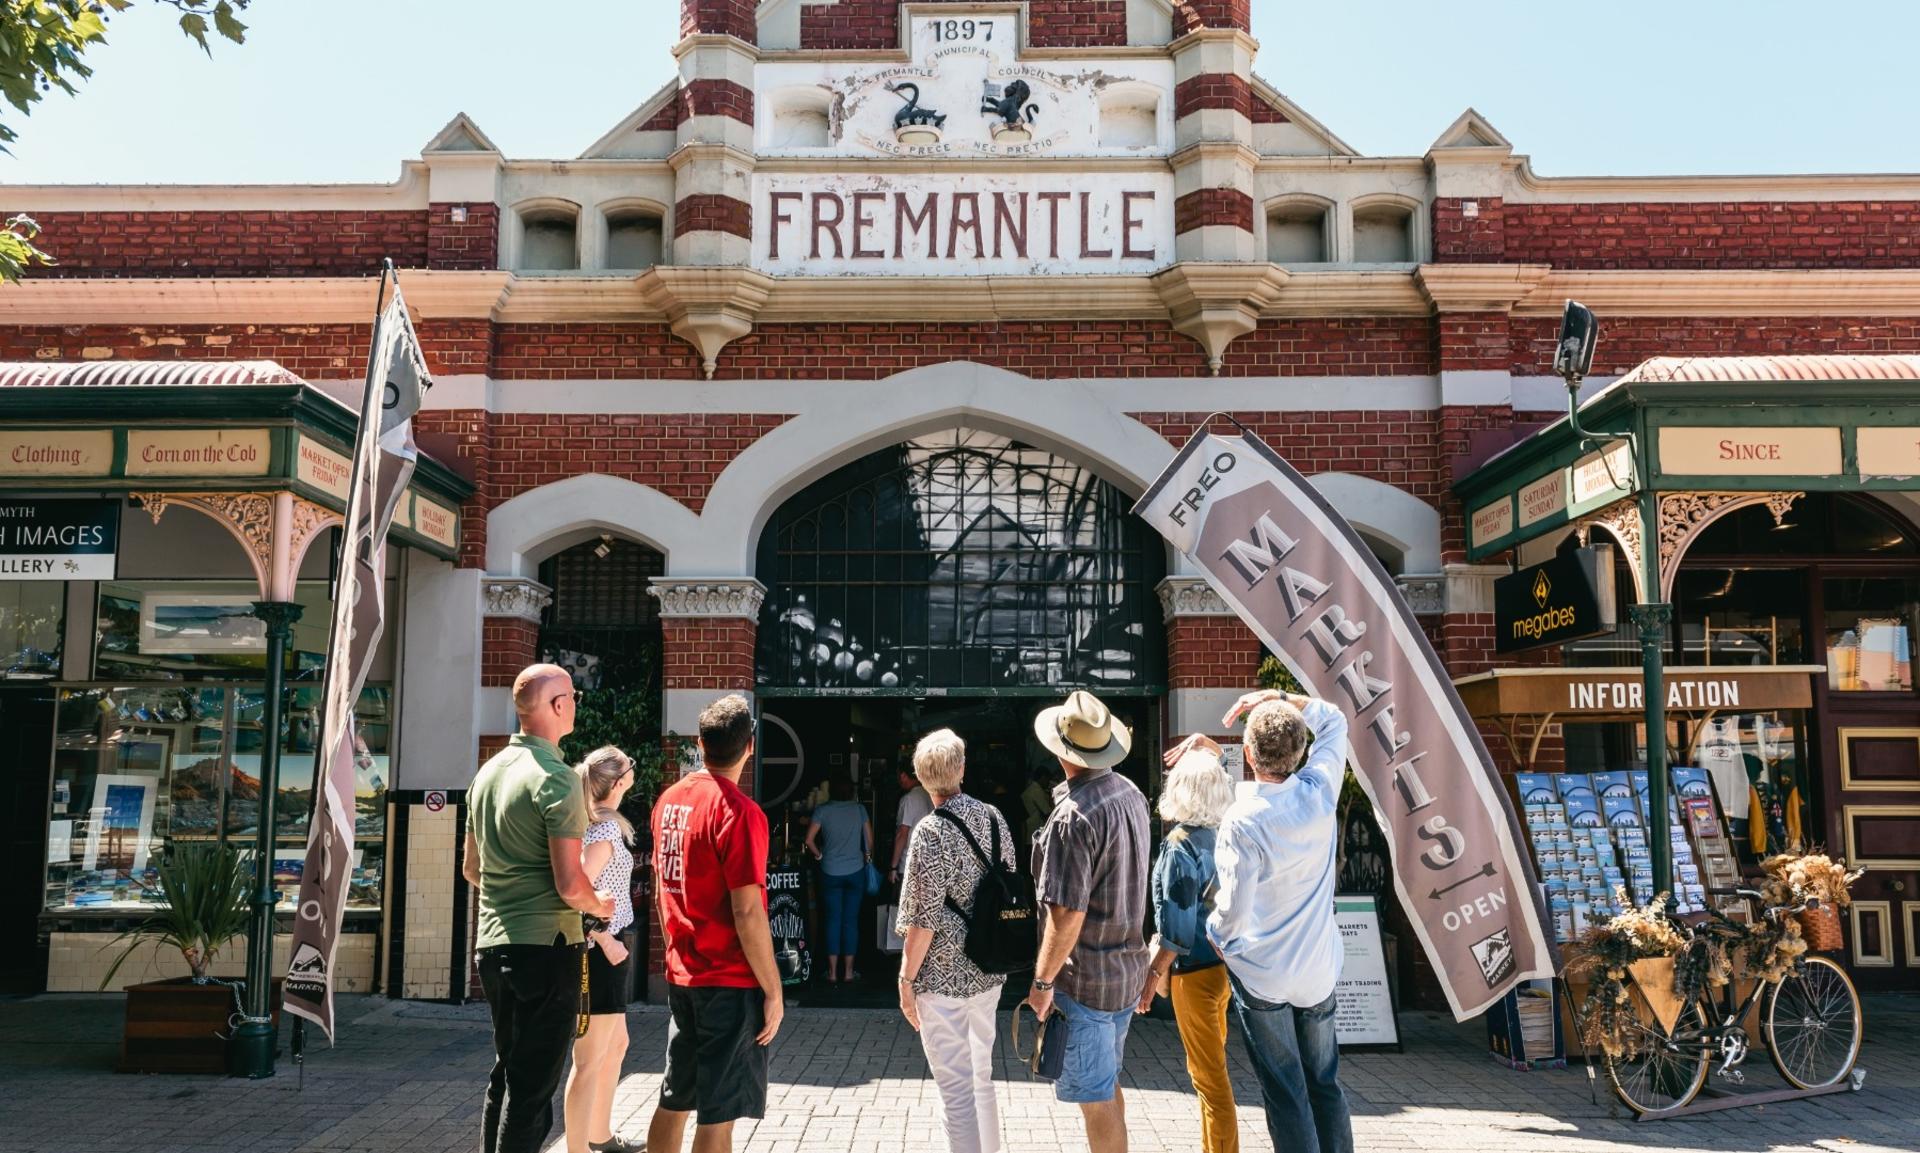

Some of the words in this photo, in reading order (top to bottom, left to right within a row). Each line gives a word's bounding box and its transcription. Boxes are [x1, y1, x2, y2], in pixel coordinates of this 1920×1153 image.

[933, 20, 994, 42] 1897
[934, 46, 990, 60] MUNICIPAL
[875, 68, 934, 82] FREMANTLE
[998, 66, 1046, 79] COUNCIL
[876, 140, 900, 154] NEC
[909, 143, 951, 156] PRECE
[974, 140, 997, 152] NEC
[1006, 138, 1053, 155] PRETIO
[768, 191, 1156, 260] FREMANTLE
[11, 444, 82, 466] Clothing
[142, 444, 179, 463] Corn
[183, 450, 200, 463] on
[203, 445, 224, 464] the
[226, 444, 256, 462] Cob
[301, 445, 331, 470] MARKET
[332, 461, 350, 479] OPEN
[312, 465, 338, 487] FRIDAY
[1168, 452, 1237, 528] FREO
[1523, 478, 1560, 506] SATURDAY
[1528, 495, 1556, 519] SUNDAY
[15, 525, 104, 546] IMAGES
[0, 559, 55, 573] LLERY
[1513, 606, 1576, 640] megabes
[1218, 509, 1466, 871] MARKETS
[1568, 680, 1740, 709] INFORATION
[765, 872, 801, 890] COFFEE
[1442, 887, 1507, 931] OPEN
